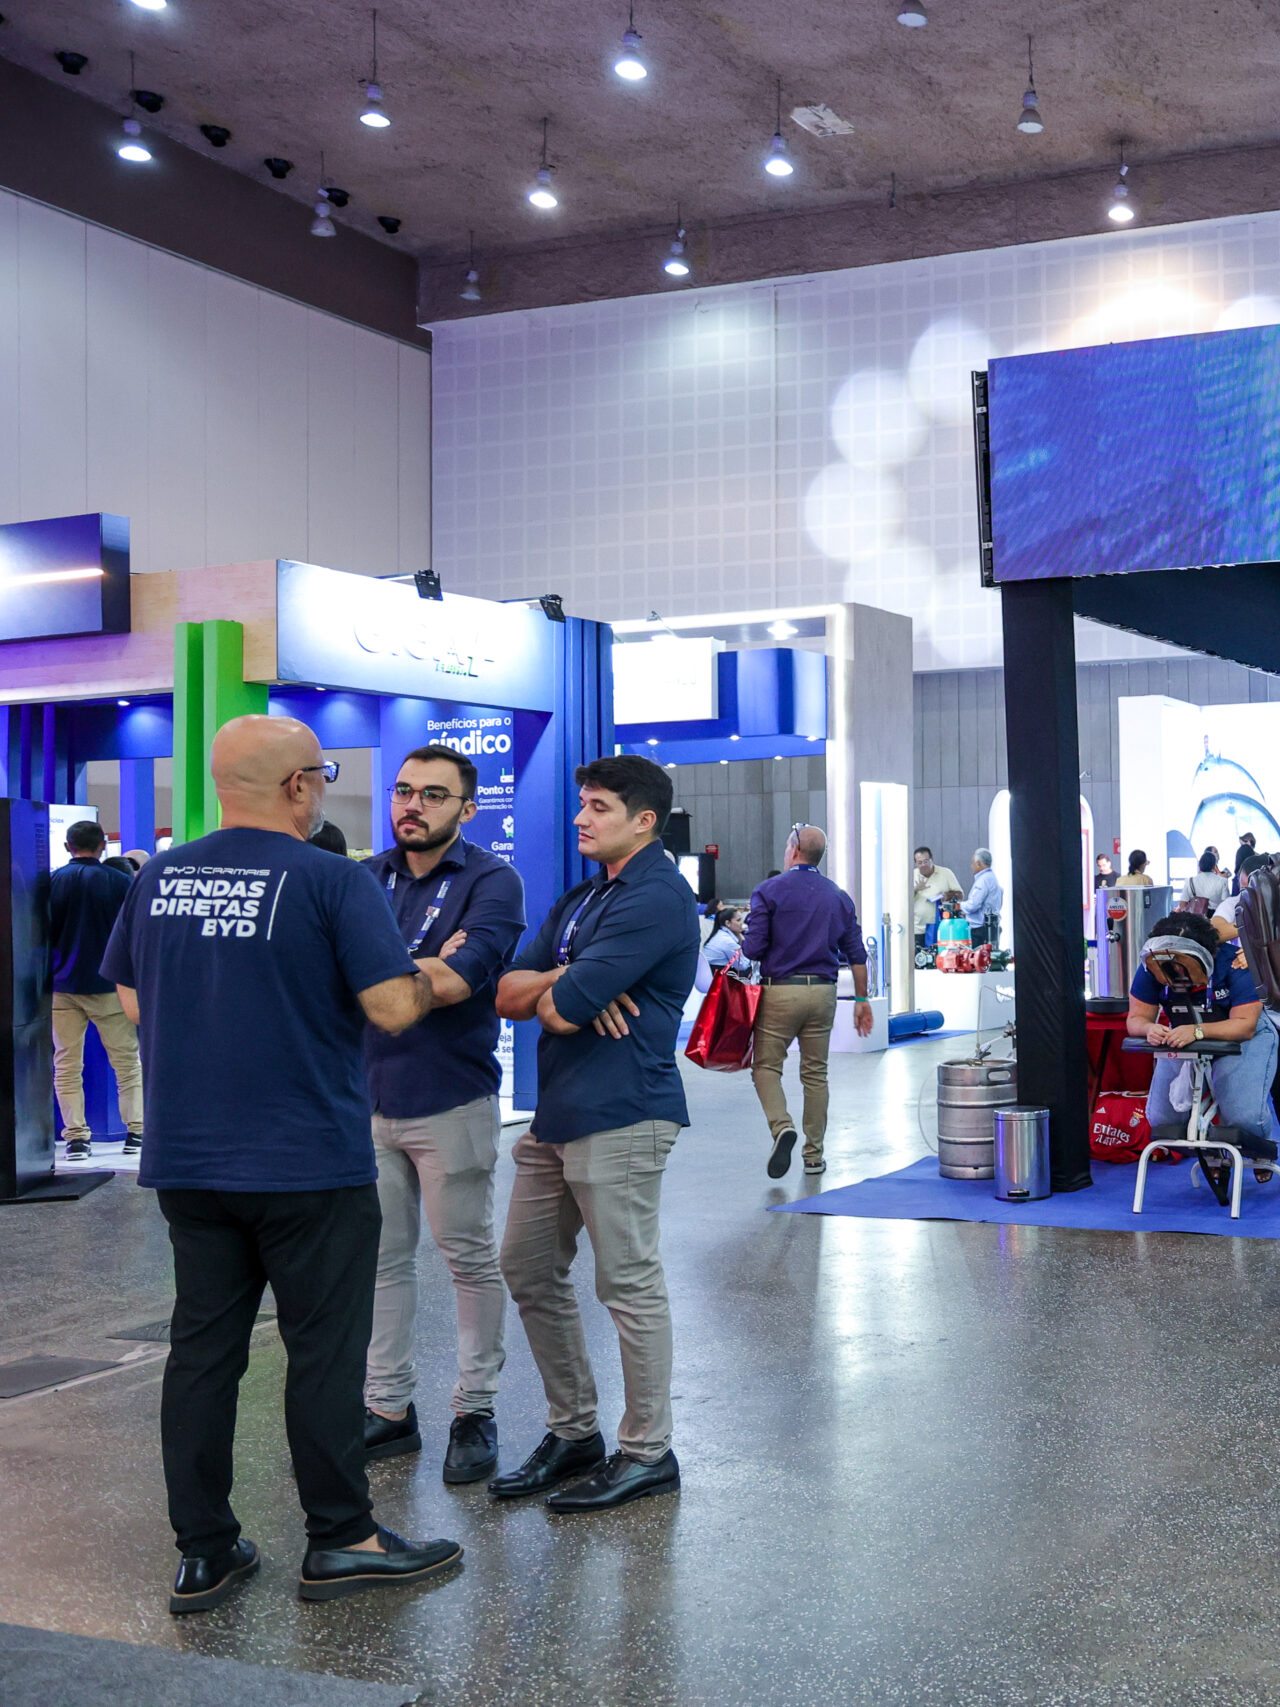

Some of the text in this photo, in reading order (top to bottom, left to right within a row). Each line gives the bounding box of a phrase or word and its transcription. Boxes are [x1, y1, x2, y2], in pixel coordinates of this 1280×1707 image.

[479, 717, 502, 729] para
[503, 717, 511, 726] o
[477, 786, 504, 796] Ponto
[163, 866, 271, 876] BYD CARMAIS
[159, 879, 267, 898] VENDAS
[150, 898, 260, 917] DIRETAS
[201, 918, 256, 938] BYD
